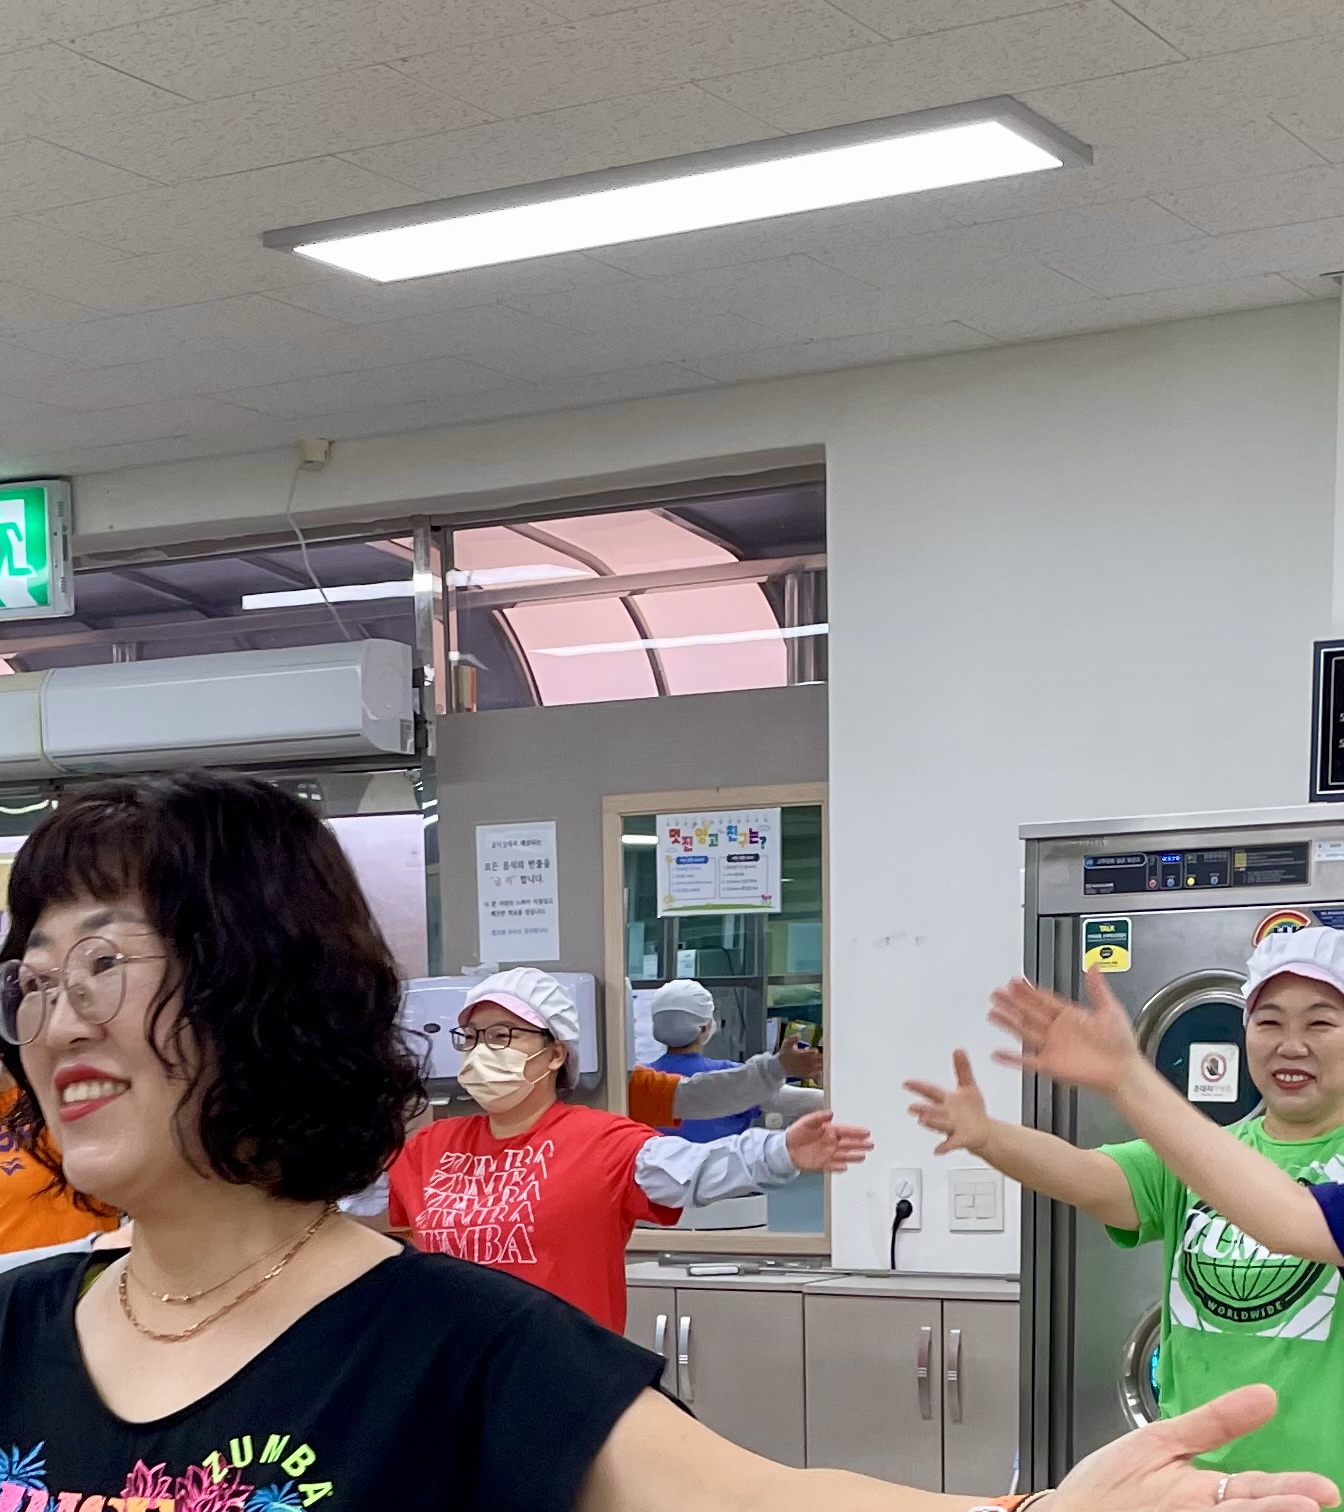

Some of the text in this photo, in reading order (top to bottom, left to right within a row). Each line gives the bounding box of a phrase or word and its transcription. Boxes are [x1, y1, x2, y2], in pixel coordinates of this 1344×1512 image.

[1184, 1209, 1293, 1261] ZUM
[1207, 1299, 1284, 1321] WORLDWIDE
[202, 1433, 333, 1507] ZUMBA
